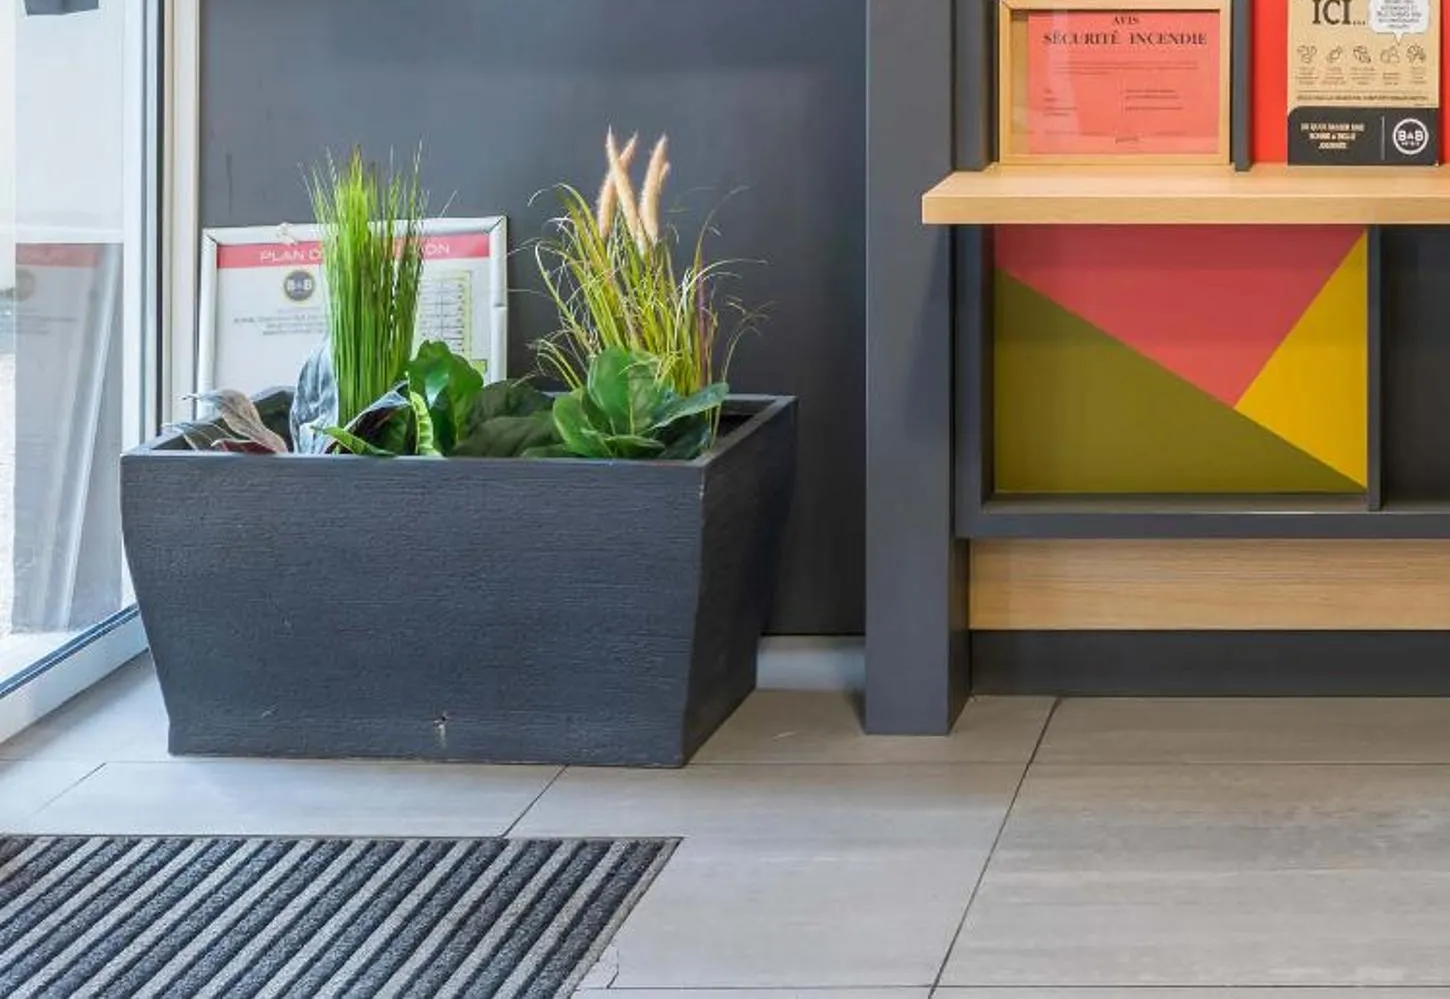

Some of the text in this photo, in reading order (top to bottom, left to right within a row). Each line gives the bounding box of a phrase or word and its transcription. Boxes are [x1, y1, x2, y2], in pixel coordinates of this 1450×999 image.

[1112, 16, 1139, 25] AVIS
[1130, 33, 1208, 46] INCENDIE
[260, 248, 304, 264] PLAN
